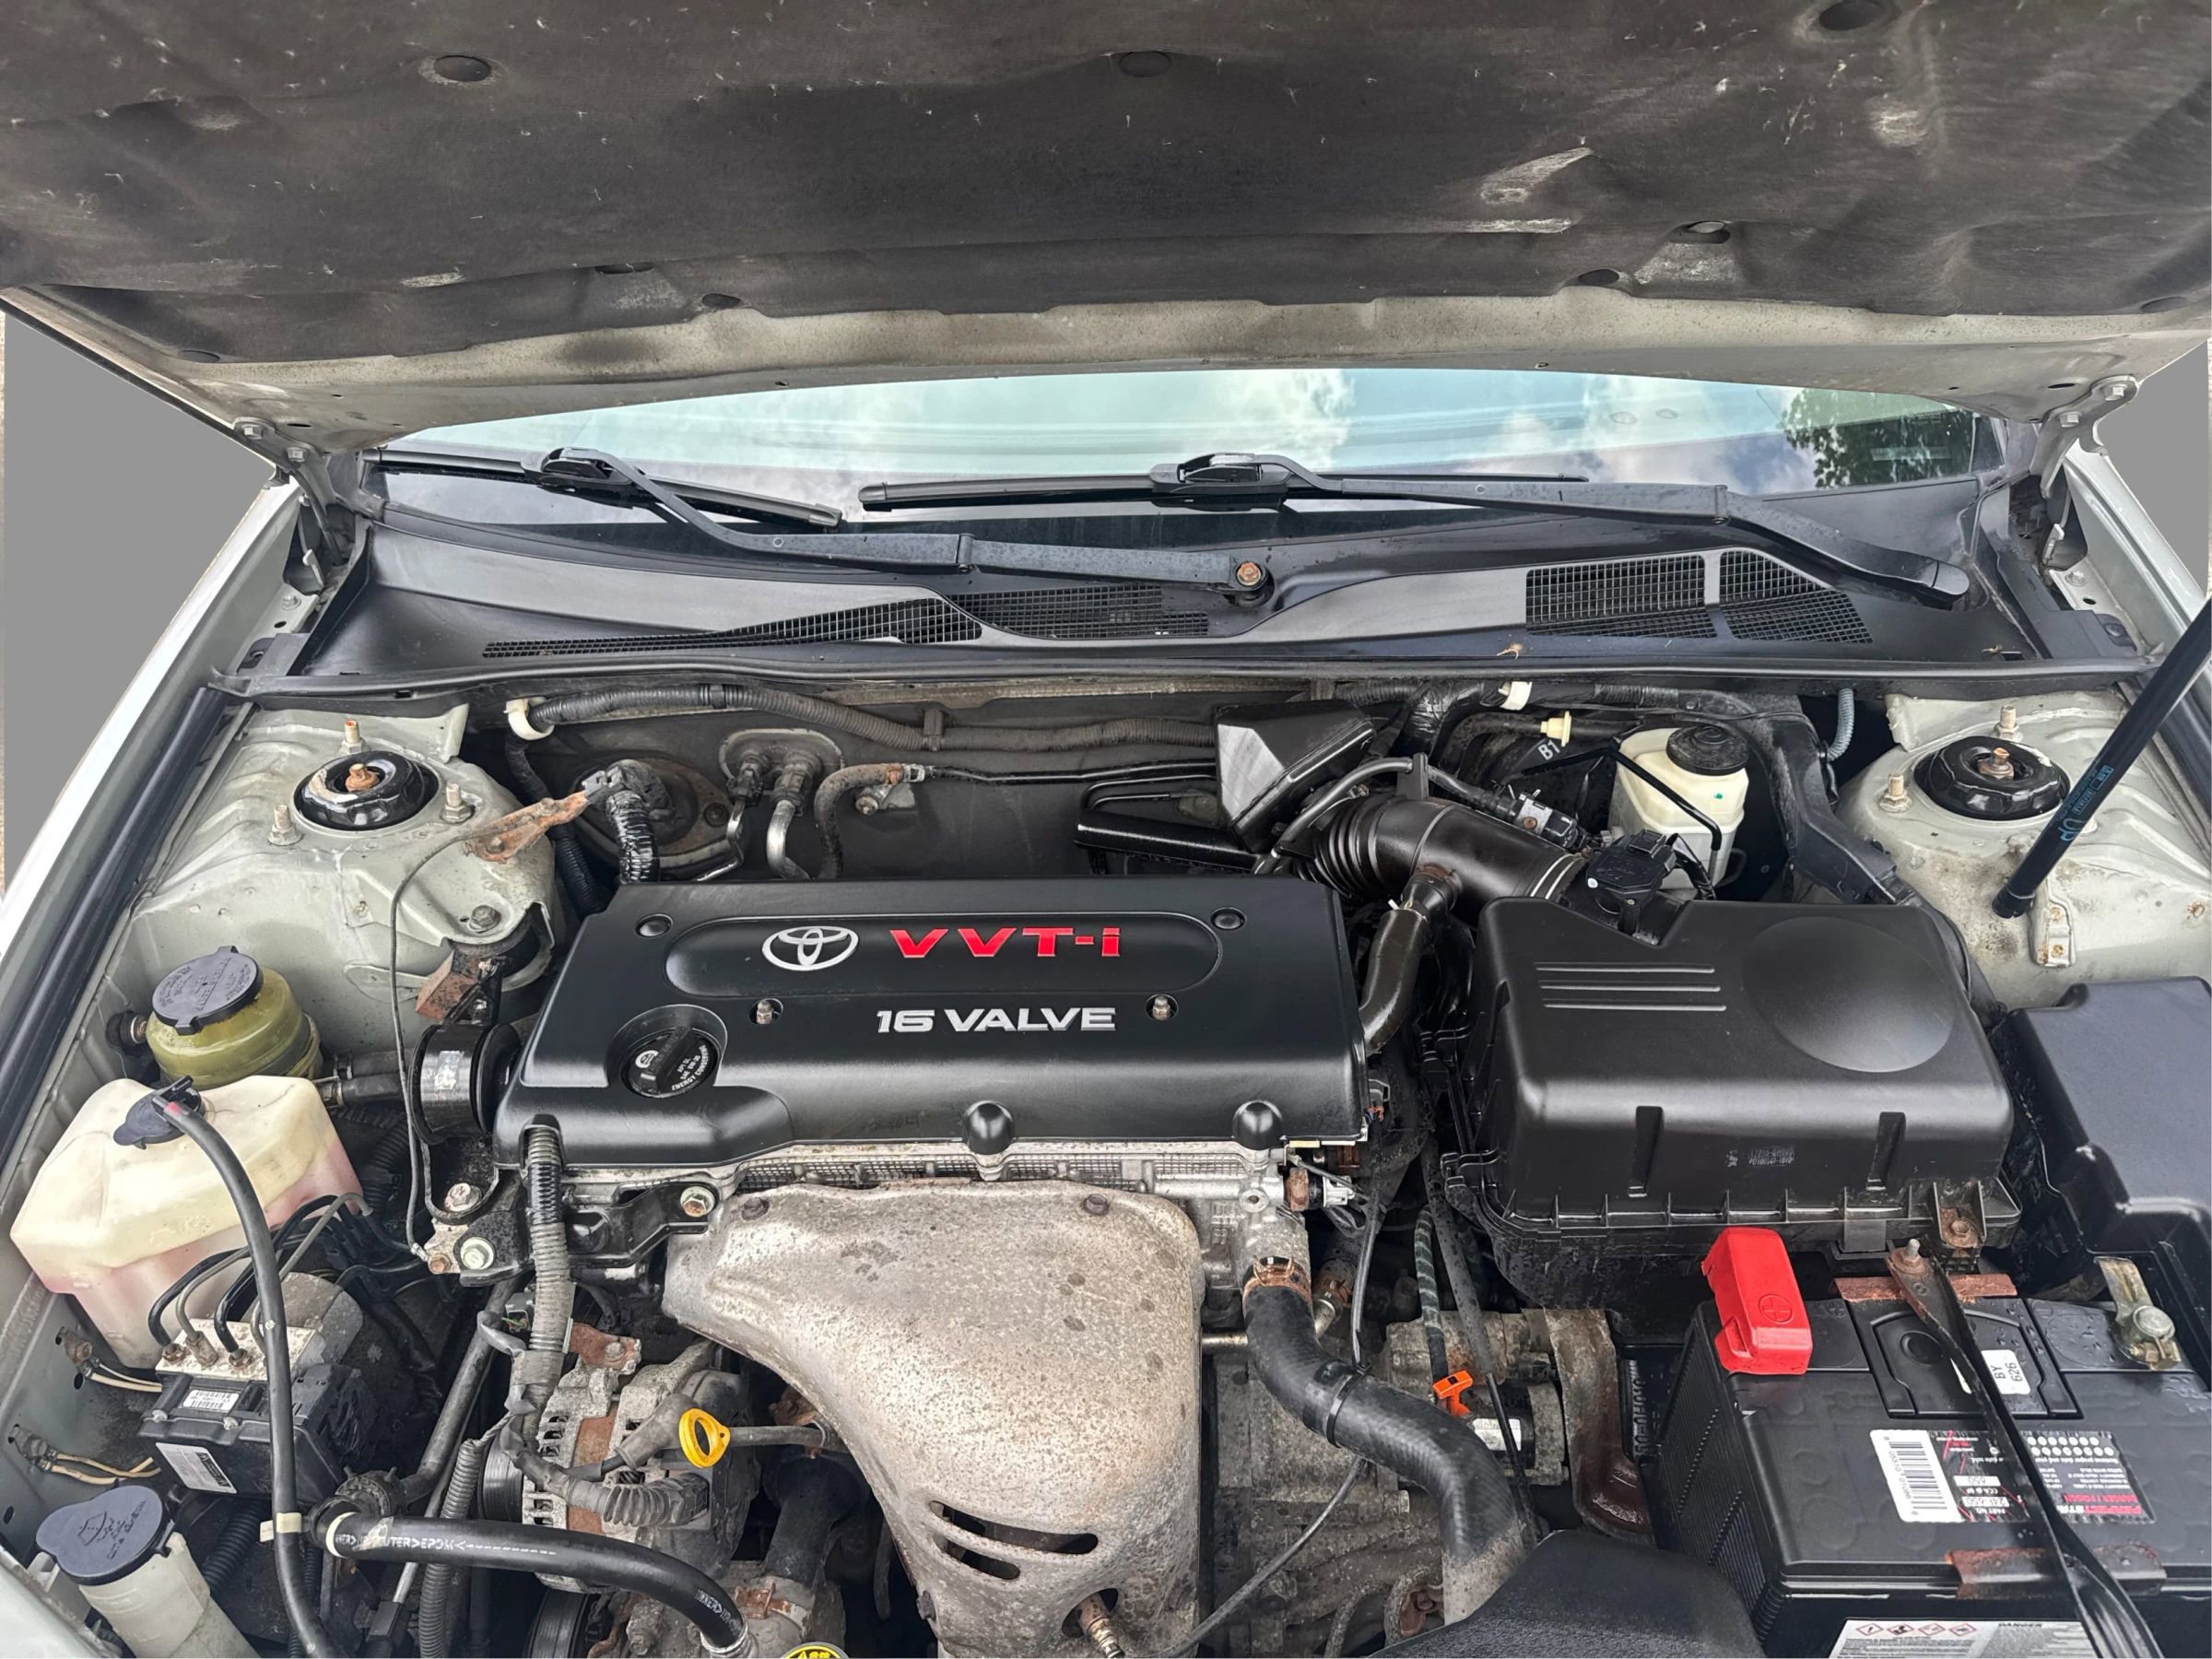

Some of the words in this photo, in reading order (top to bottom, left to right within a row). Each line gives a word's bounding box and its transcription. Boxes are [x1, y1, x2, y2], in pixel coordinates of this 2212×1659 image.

[1537, 739, 1560, 760] B1
[889, 927, 1121, 959] VVT-i
[877, 1009, 935, 1033] 16
[943, 1007, 1117, 1032] VALVE
[672, 1075, 697, 1090] ENERGY
[695, 1045, 709, 1076] CONSERVING
[1990, 1365, 2006, 1379] BY
[2005, 1362, 2023, 1382] 626
